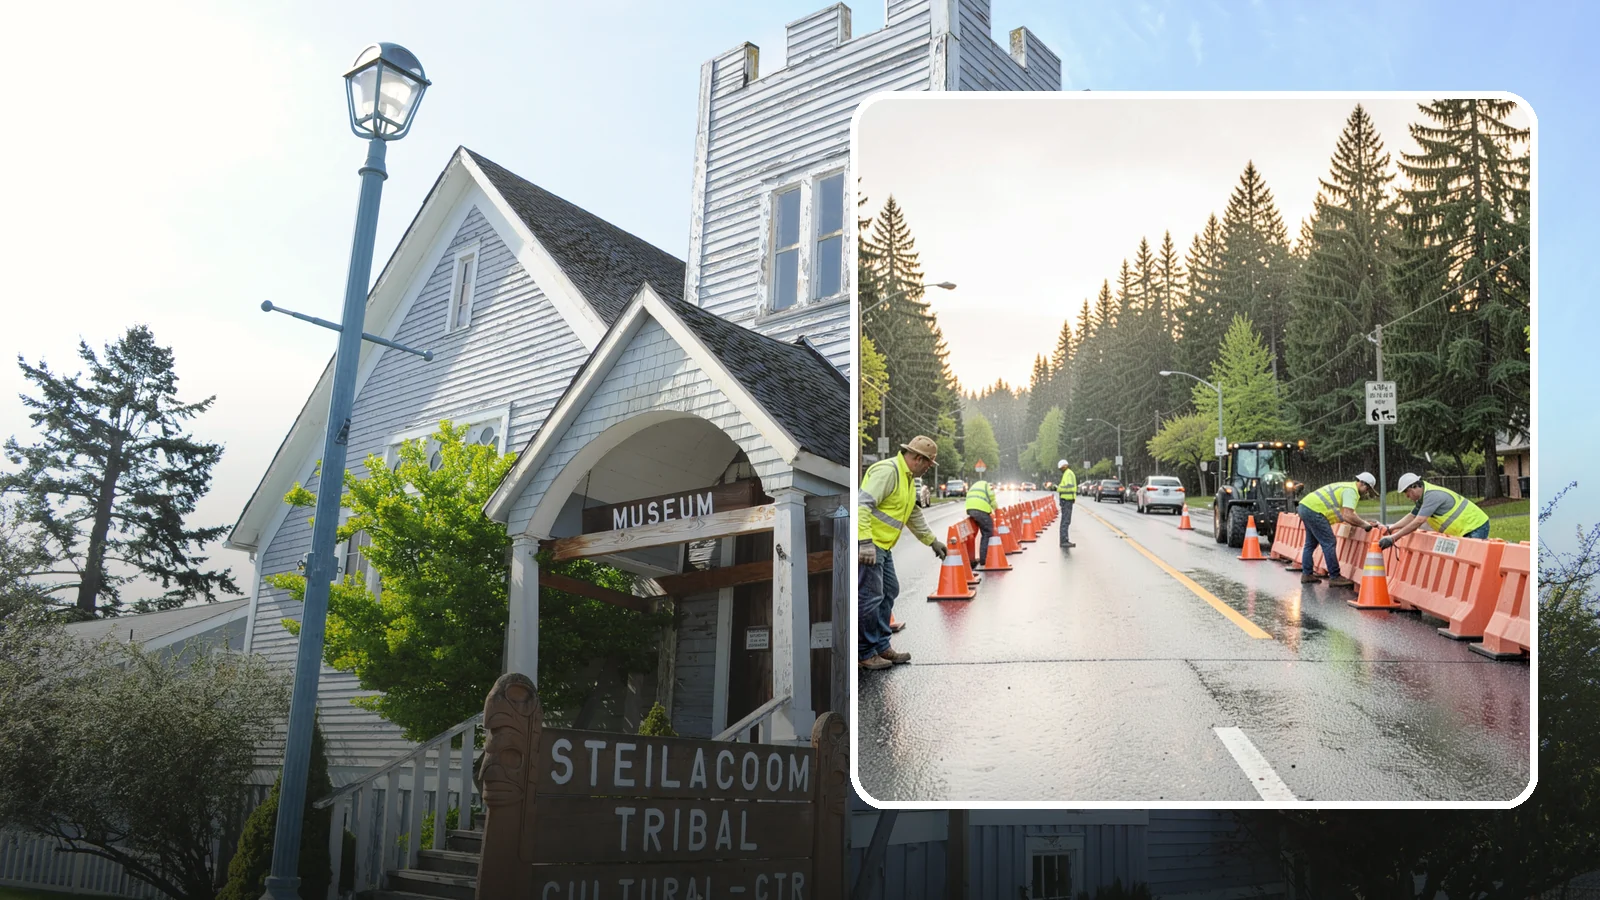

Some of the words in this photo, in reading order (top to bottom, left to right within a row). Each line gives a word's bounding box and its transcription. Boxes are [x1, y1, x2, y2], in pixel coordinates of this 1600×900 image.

[613, 492, 713, 531] MUSEUM
[551, 738, 809, 792] STEILACOOM
[615, 807, 757, 851] TRIBAL
